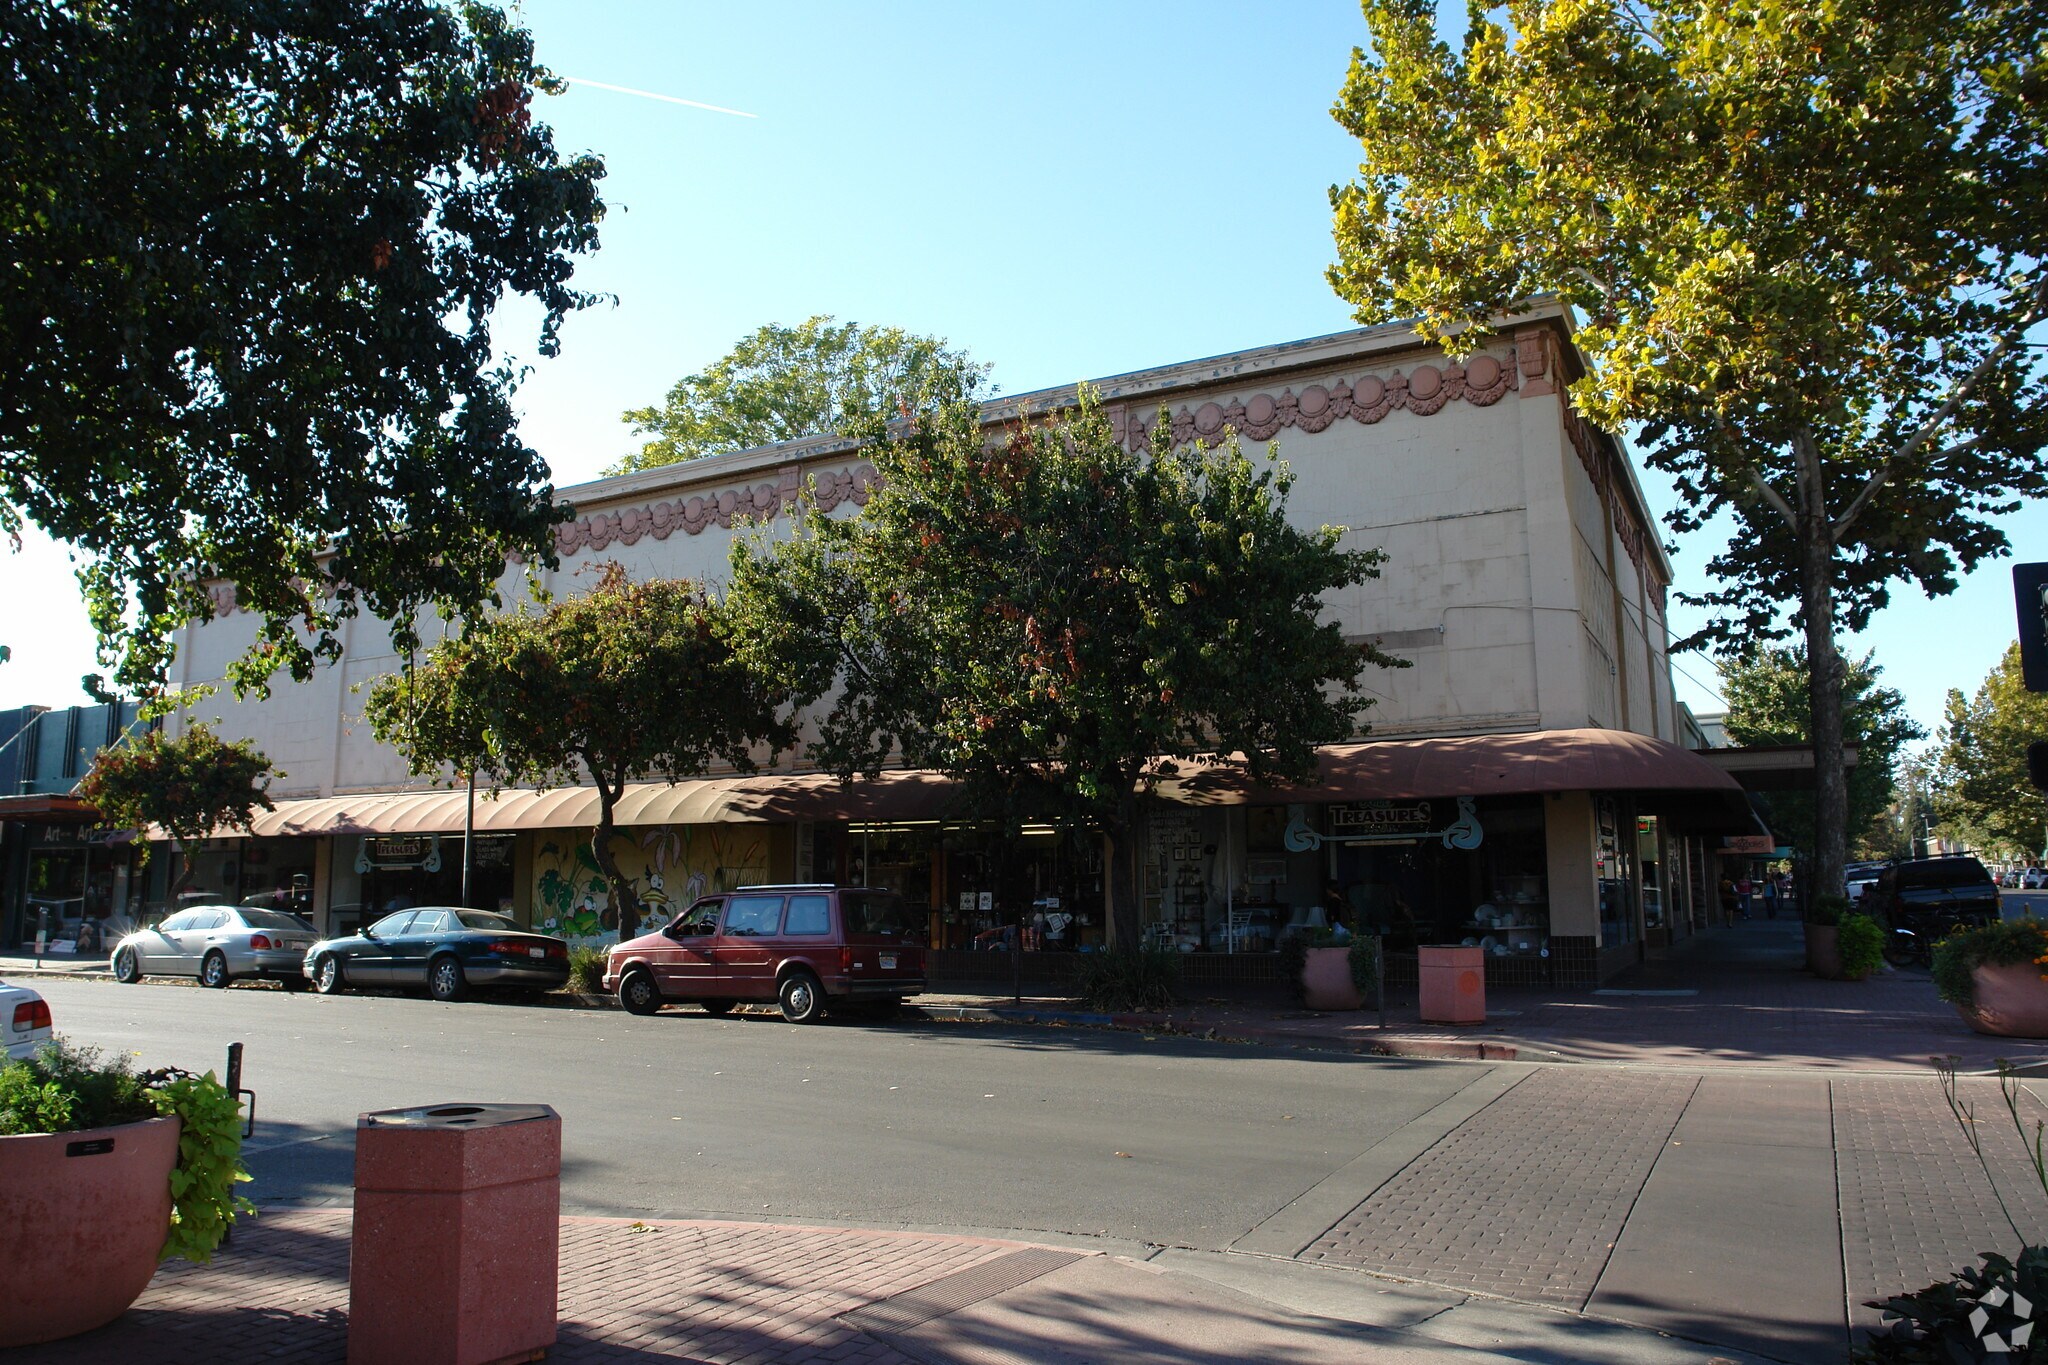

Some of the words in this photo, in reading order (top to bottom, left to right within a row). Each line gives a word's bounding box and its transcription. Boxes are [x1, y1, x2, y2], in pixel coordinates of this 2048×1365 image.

[1331, 802, 1431, 824] TREASURES
[44, 826, 60, 841] Art
[377, 841, 420, 855] TREASURES
